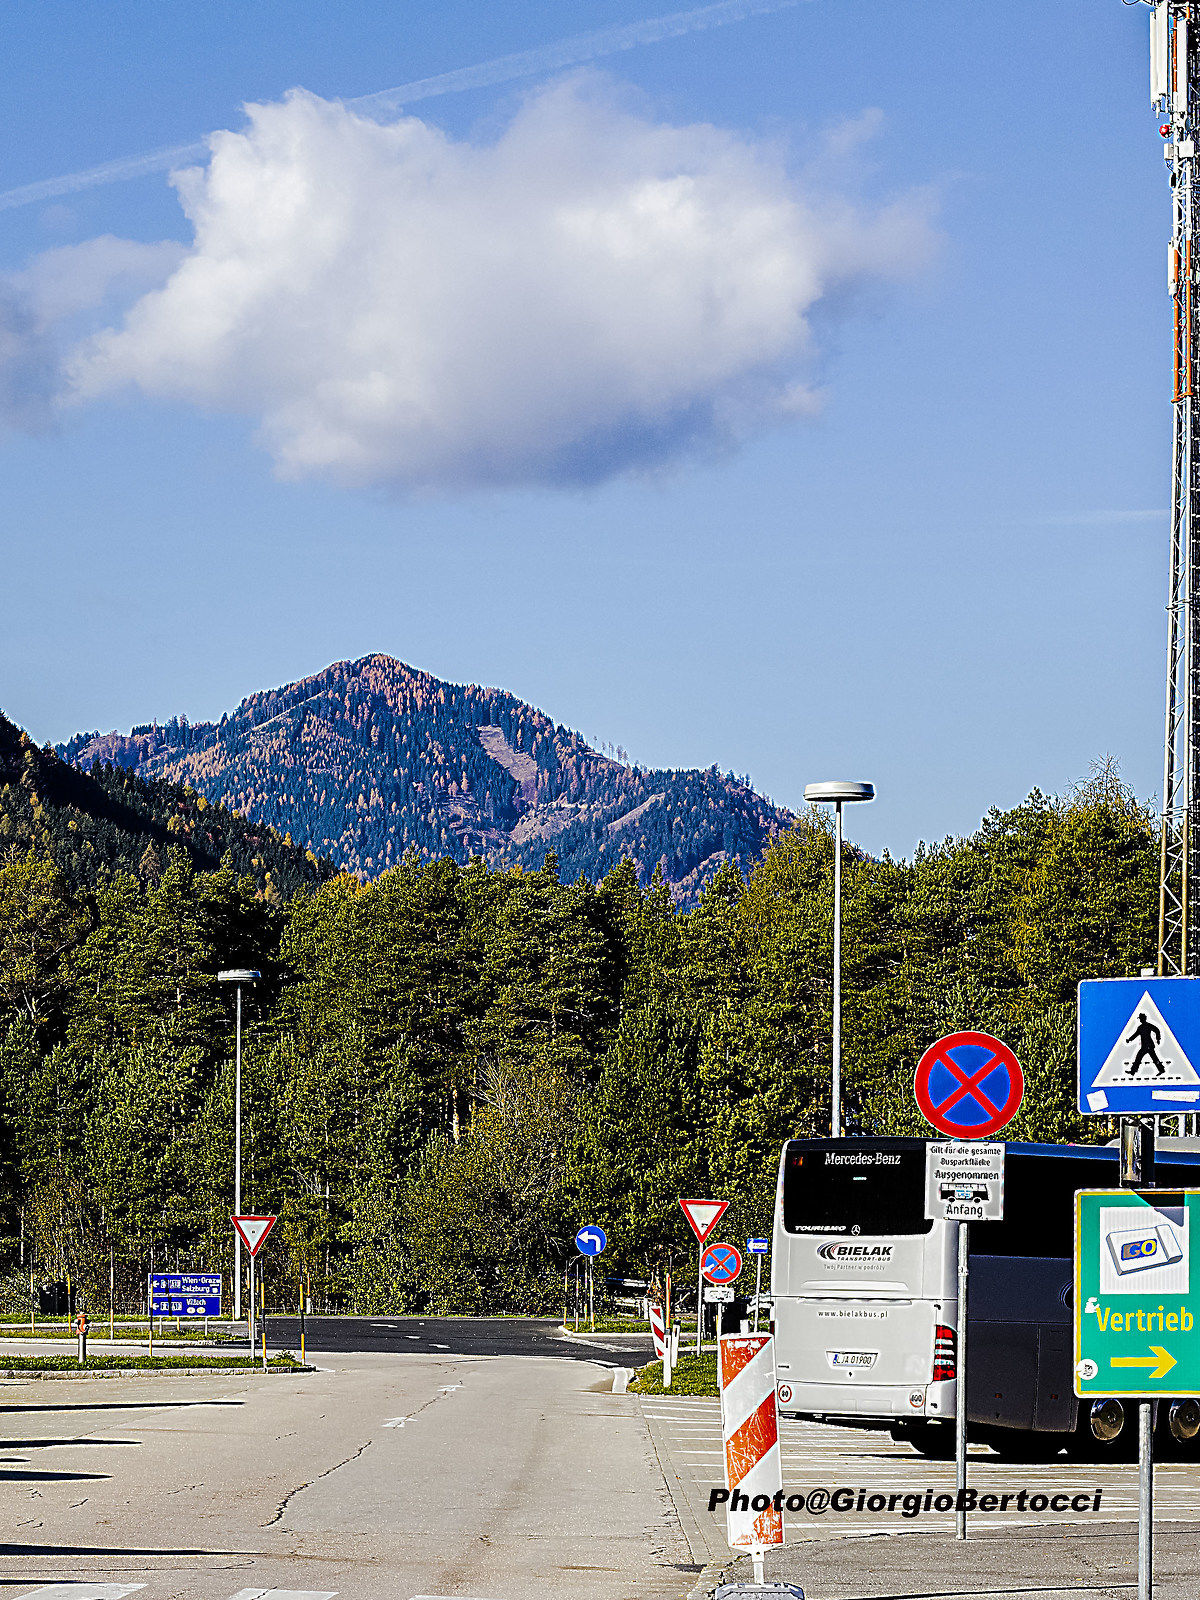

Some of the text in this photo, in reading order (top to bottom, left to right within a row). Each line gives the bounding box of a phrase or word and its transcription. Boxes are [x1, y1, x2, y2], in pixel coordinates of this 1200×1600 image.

[930, 1145, 943, 1154] Gilt
[945, 1146, 956, 1154] für
[824, 1152, 901, 1165] Mercedes-Benz
[935, 1169, 999, 1181] Ausgenommen
[946, 1204, 983, 1217] Anfang
[837, 1246, 893, 1256] BIELAK
[1122, 1239, 1157, 1260] GO
[181, 1276, 198, 1284] Wien
[181, 1285, 210, 1293] Salzburg
[186, 1298, 207, 1306] Villach
[817, 1310, 889, 1319] www.bielakbus.pl
[1096, 1305, 1194, 1332] Vertrieb
